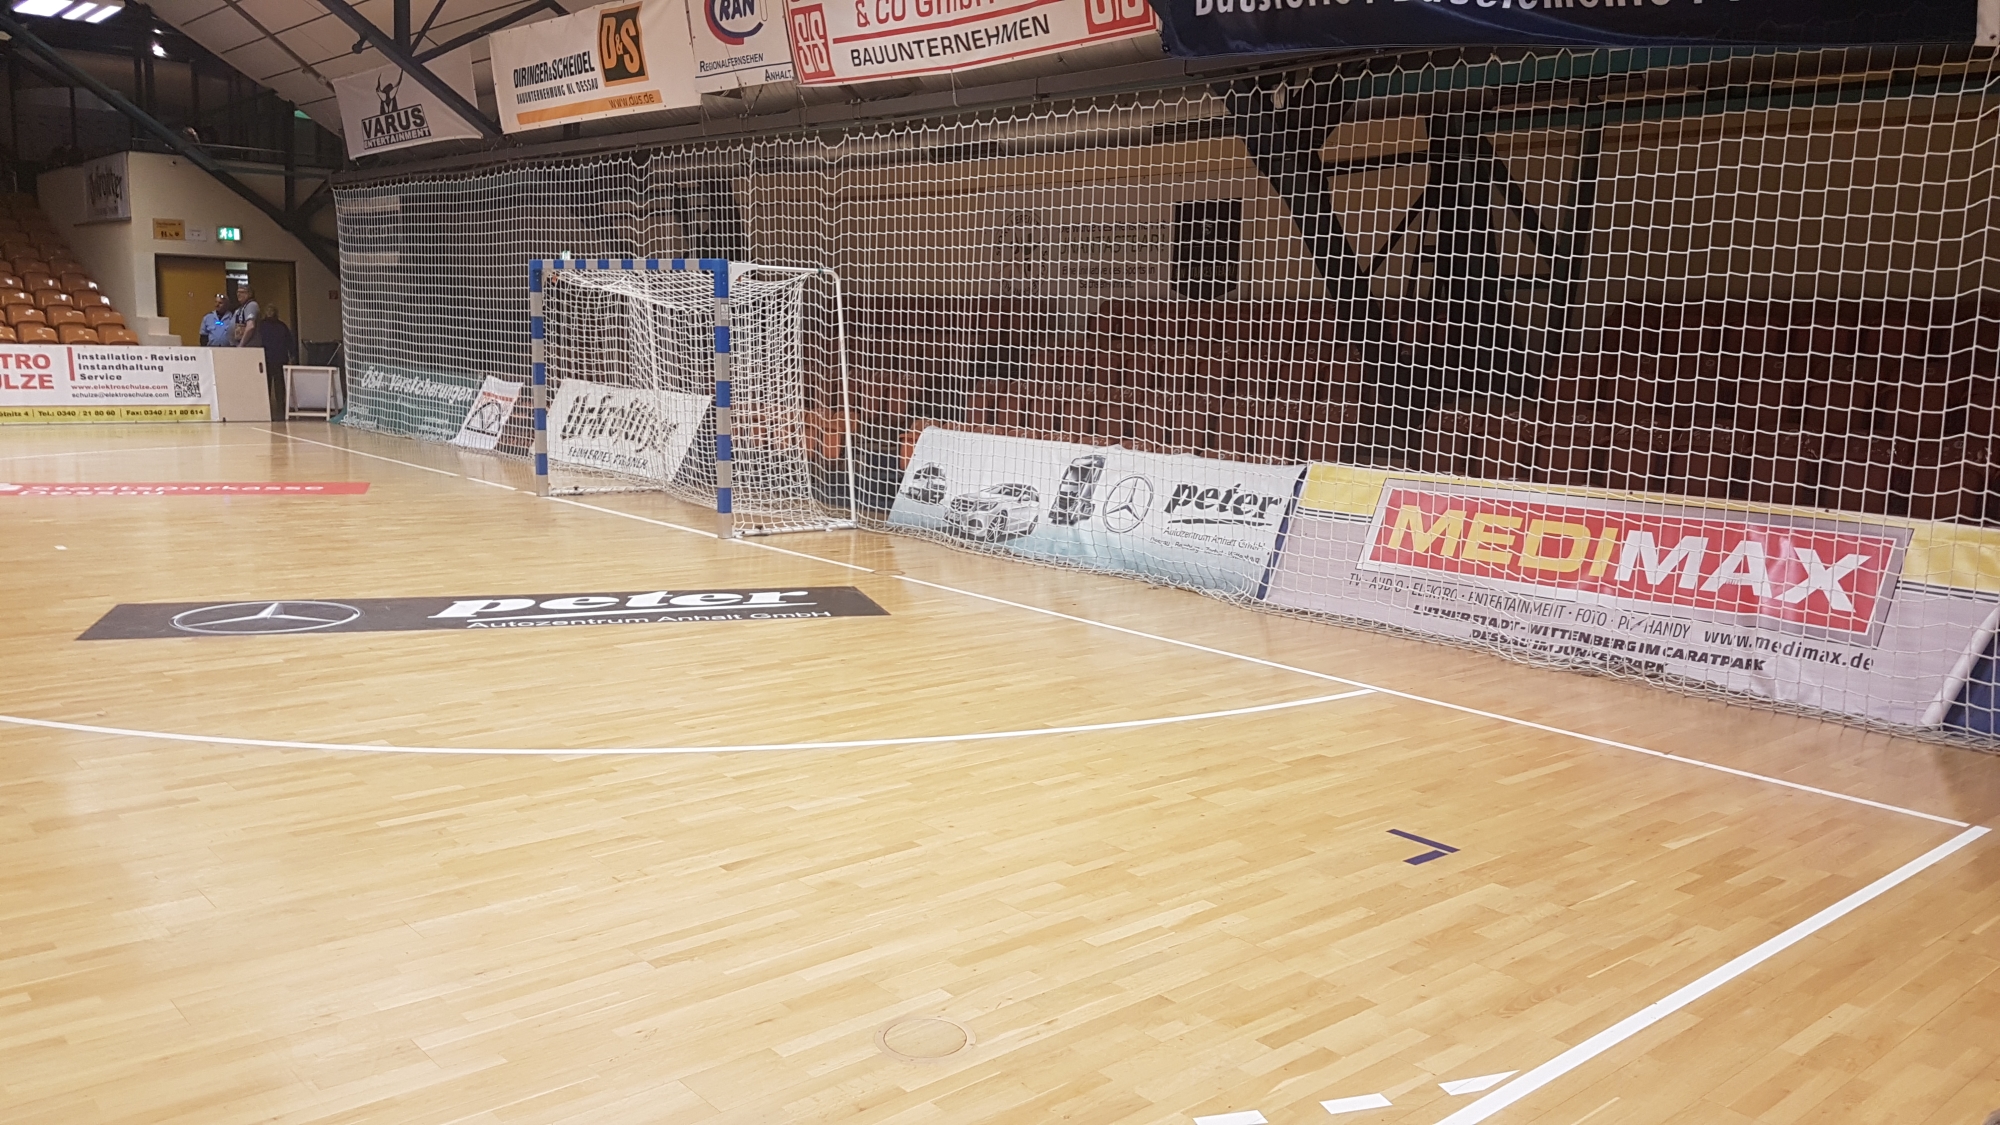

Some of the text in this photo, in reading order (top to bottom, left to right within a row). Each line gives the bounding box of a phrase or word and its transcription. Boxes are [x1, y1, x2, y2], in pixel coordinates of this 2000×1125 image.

[601, 16, 641, 74] D&S
[850, 13, 1050, 67] BAUUNTERNEHMEN
[516, 83, 566, 105] BAUUNTERNEHMUNG
[575, 77, 600, 93] DESSAU
[609, 92, 655, 109] www.dus.de
[362, 107, 427, 139] VARUS
[363, 127, 431, 150] ENTERTAINMENT
[77, 353, 197, 362] Installation Revision
[78, 363, 164, 372] Instandhaltung
[80, 373, 122, 381] Service
[1163, 482, 1283, 520] peter
[1386, 503, 1871, 614] MEDIMAX
[426, 590, 809, 619] peter
[1368, 576, 1405, 593] AUDIO
[1467, 591, 1567, 619] ENTERTAINMENT
[1574, 608, 1608, 627] FOTO
[466, 611, 832, 629] Autozentrum Anhalt GmbH
[1638, 642, 1662, 656] IM
[1662, 646, 1767, 671] CARATPARK
[1703, 630, 1875, 671] www.medimax.de
